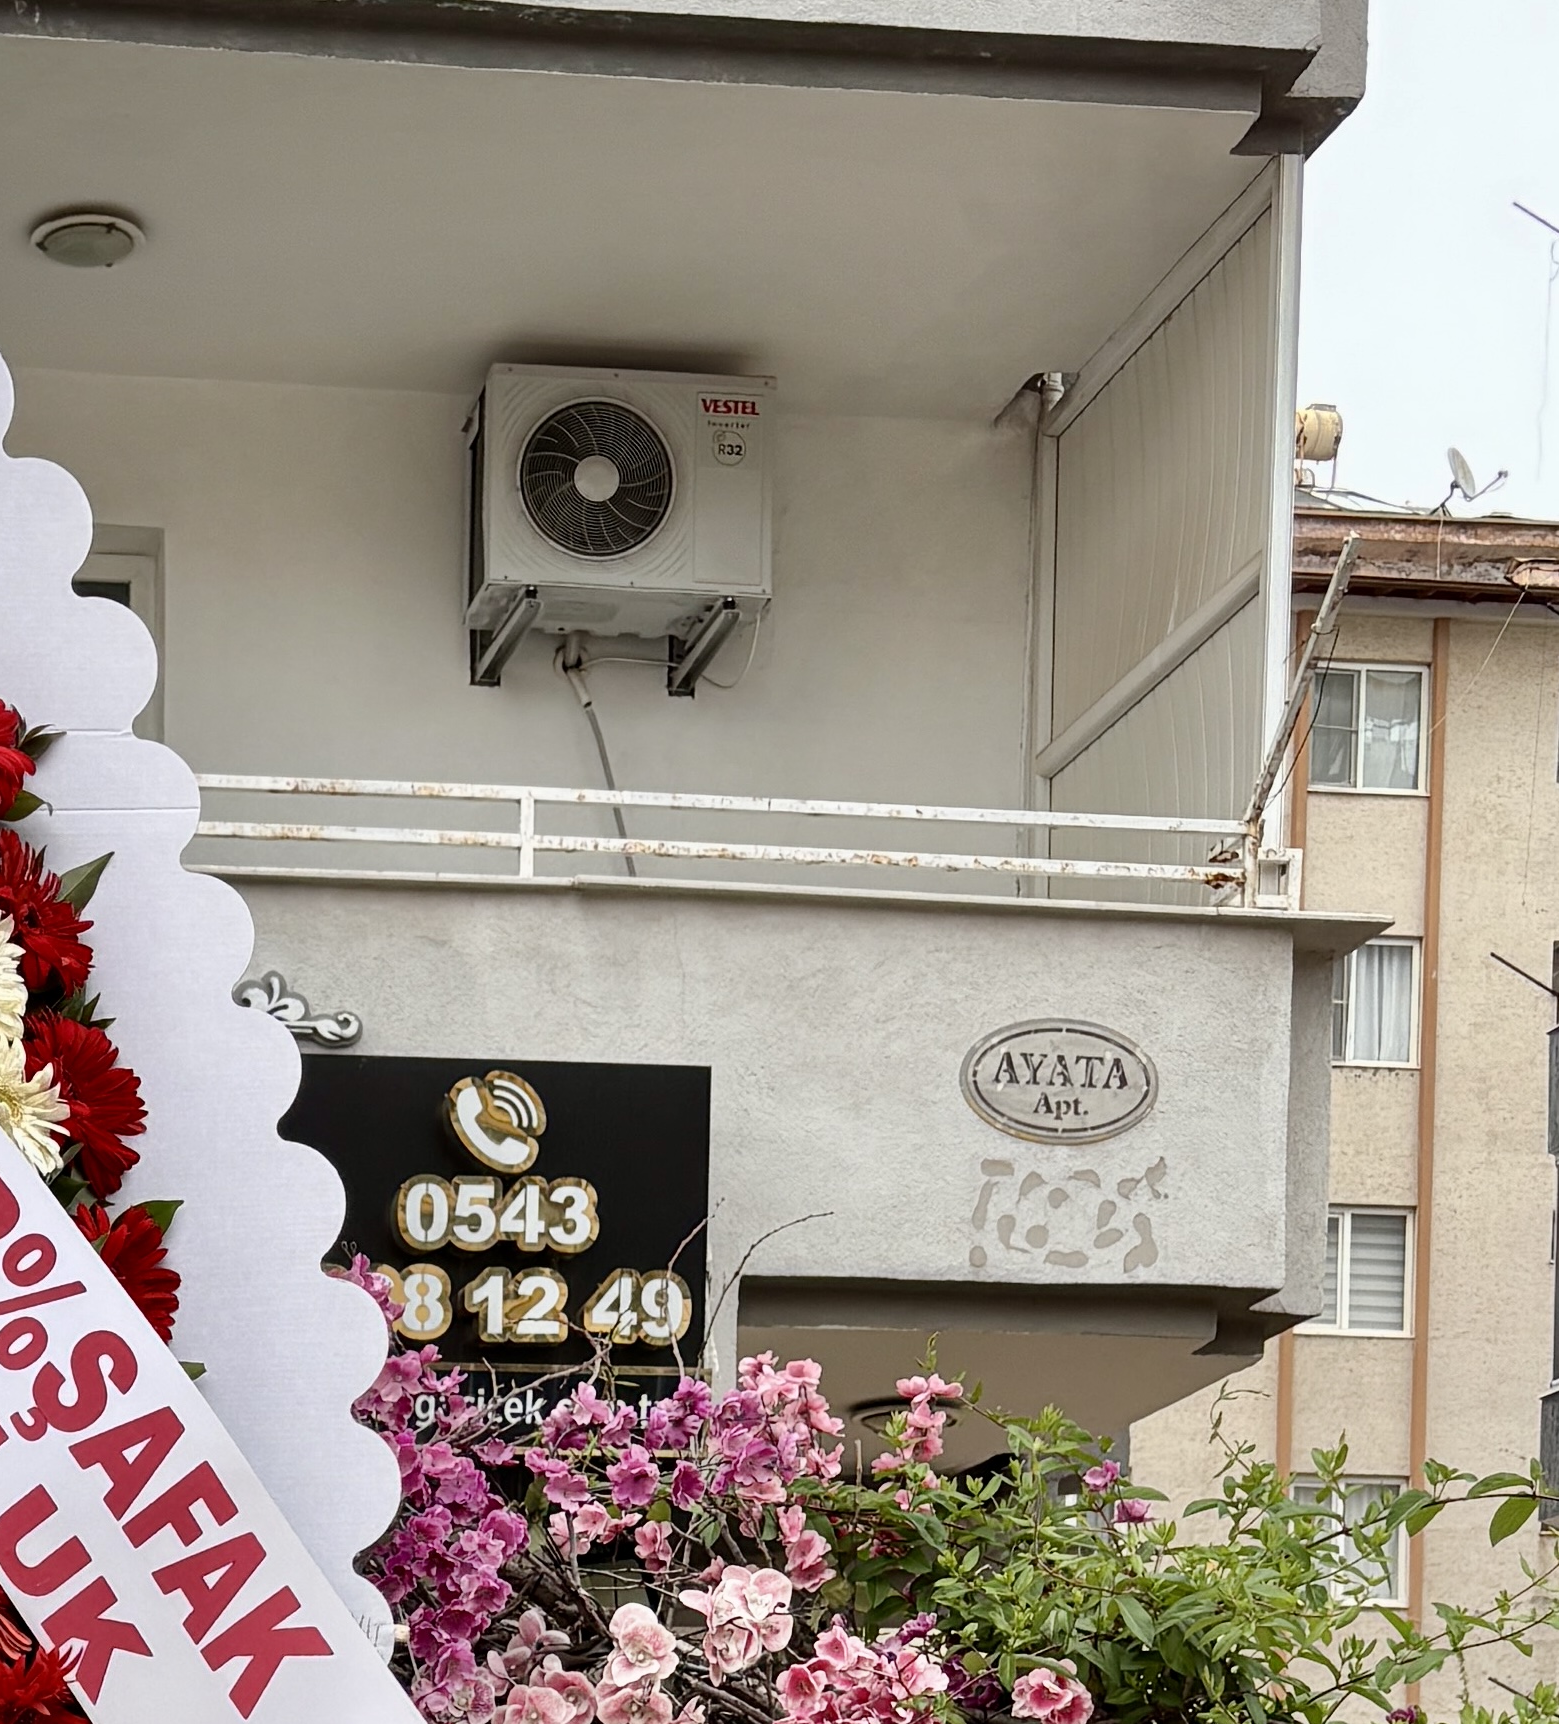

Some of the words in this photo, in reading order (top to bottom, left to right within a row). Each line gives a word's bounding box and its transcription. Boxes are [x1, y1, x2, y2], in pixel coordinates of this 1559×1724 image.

[701, 398, 760, 416] VESTEL
[718, 443, 743, 456] R32
[993, 1052, 1129, 1090] AYATA
[1033, 1092, 1090, 1120] Apt.
[402, 1179, 595, 1248] 0543
[468, 1271, 563, 1338] 12
[589, 1272, 687, 1340] 49
